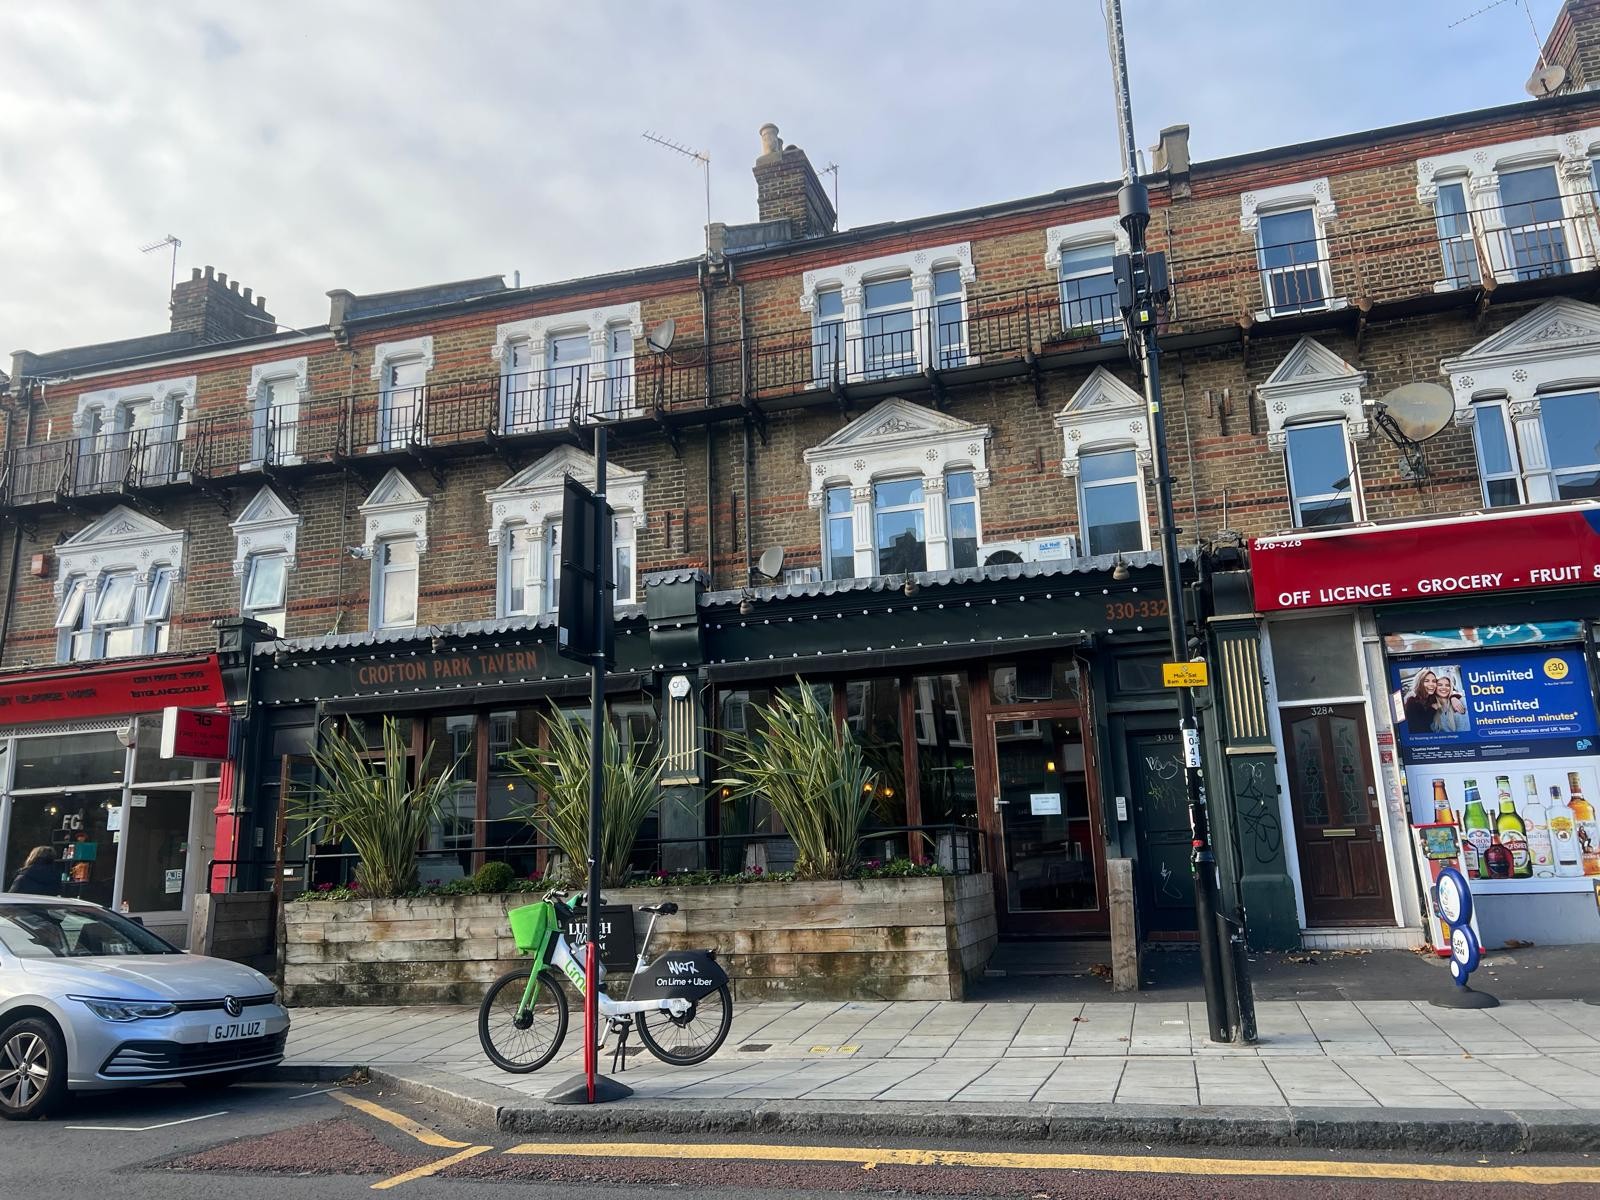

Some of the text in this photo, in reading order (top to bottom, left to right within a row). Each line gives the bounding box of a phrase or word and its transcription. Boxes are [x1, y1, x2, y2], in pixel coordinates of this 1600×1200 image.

[1278, 590, 1311, 606] OFF
[1320, 583, 1392, 603] LICENCE
[1417, 573, 1503, 593] GROCERY
[1530, 565, 1582, 583] FRUIT
[1105, 600, 1168, 620] 330-332
[359, 650, 537, 685] CROFTON PARK TAVERN
[1547, 662, 1565, 672] £30
[1468, 668, 1534, 683] Unlimited
[1470, 684, 1504, 696] Data
[1311, 706, 1334, 716] 328A
[1473, 697, 1540, 713] Unlimited
[1476, 713, 1536, 726] international
[1156, 734, 1174, 742] 330
[568, 922, 612, 935] LUH
[564, 959, 587, 993] Lim
[656, 978, 668, 986] On
[668, 977, 687, 986] Lime
[693, 977, 713, 986] Uber
[215, 1021, 261, 1039] GJ71 LUZ
